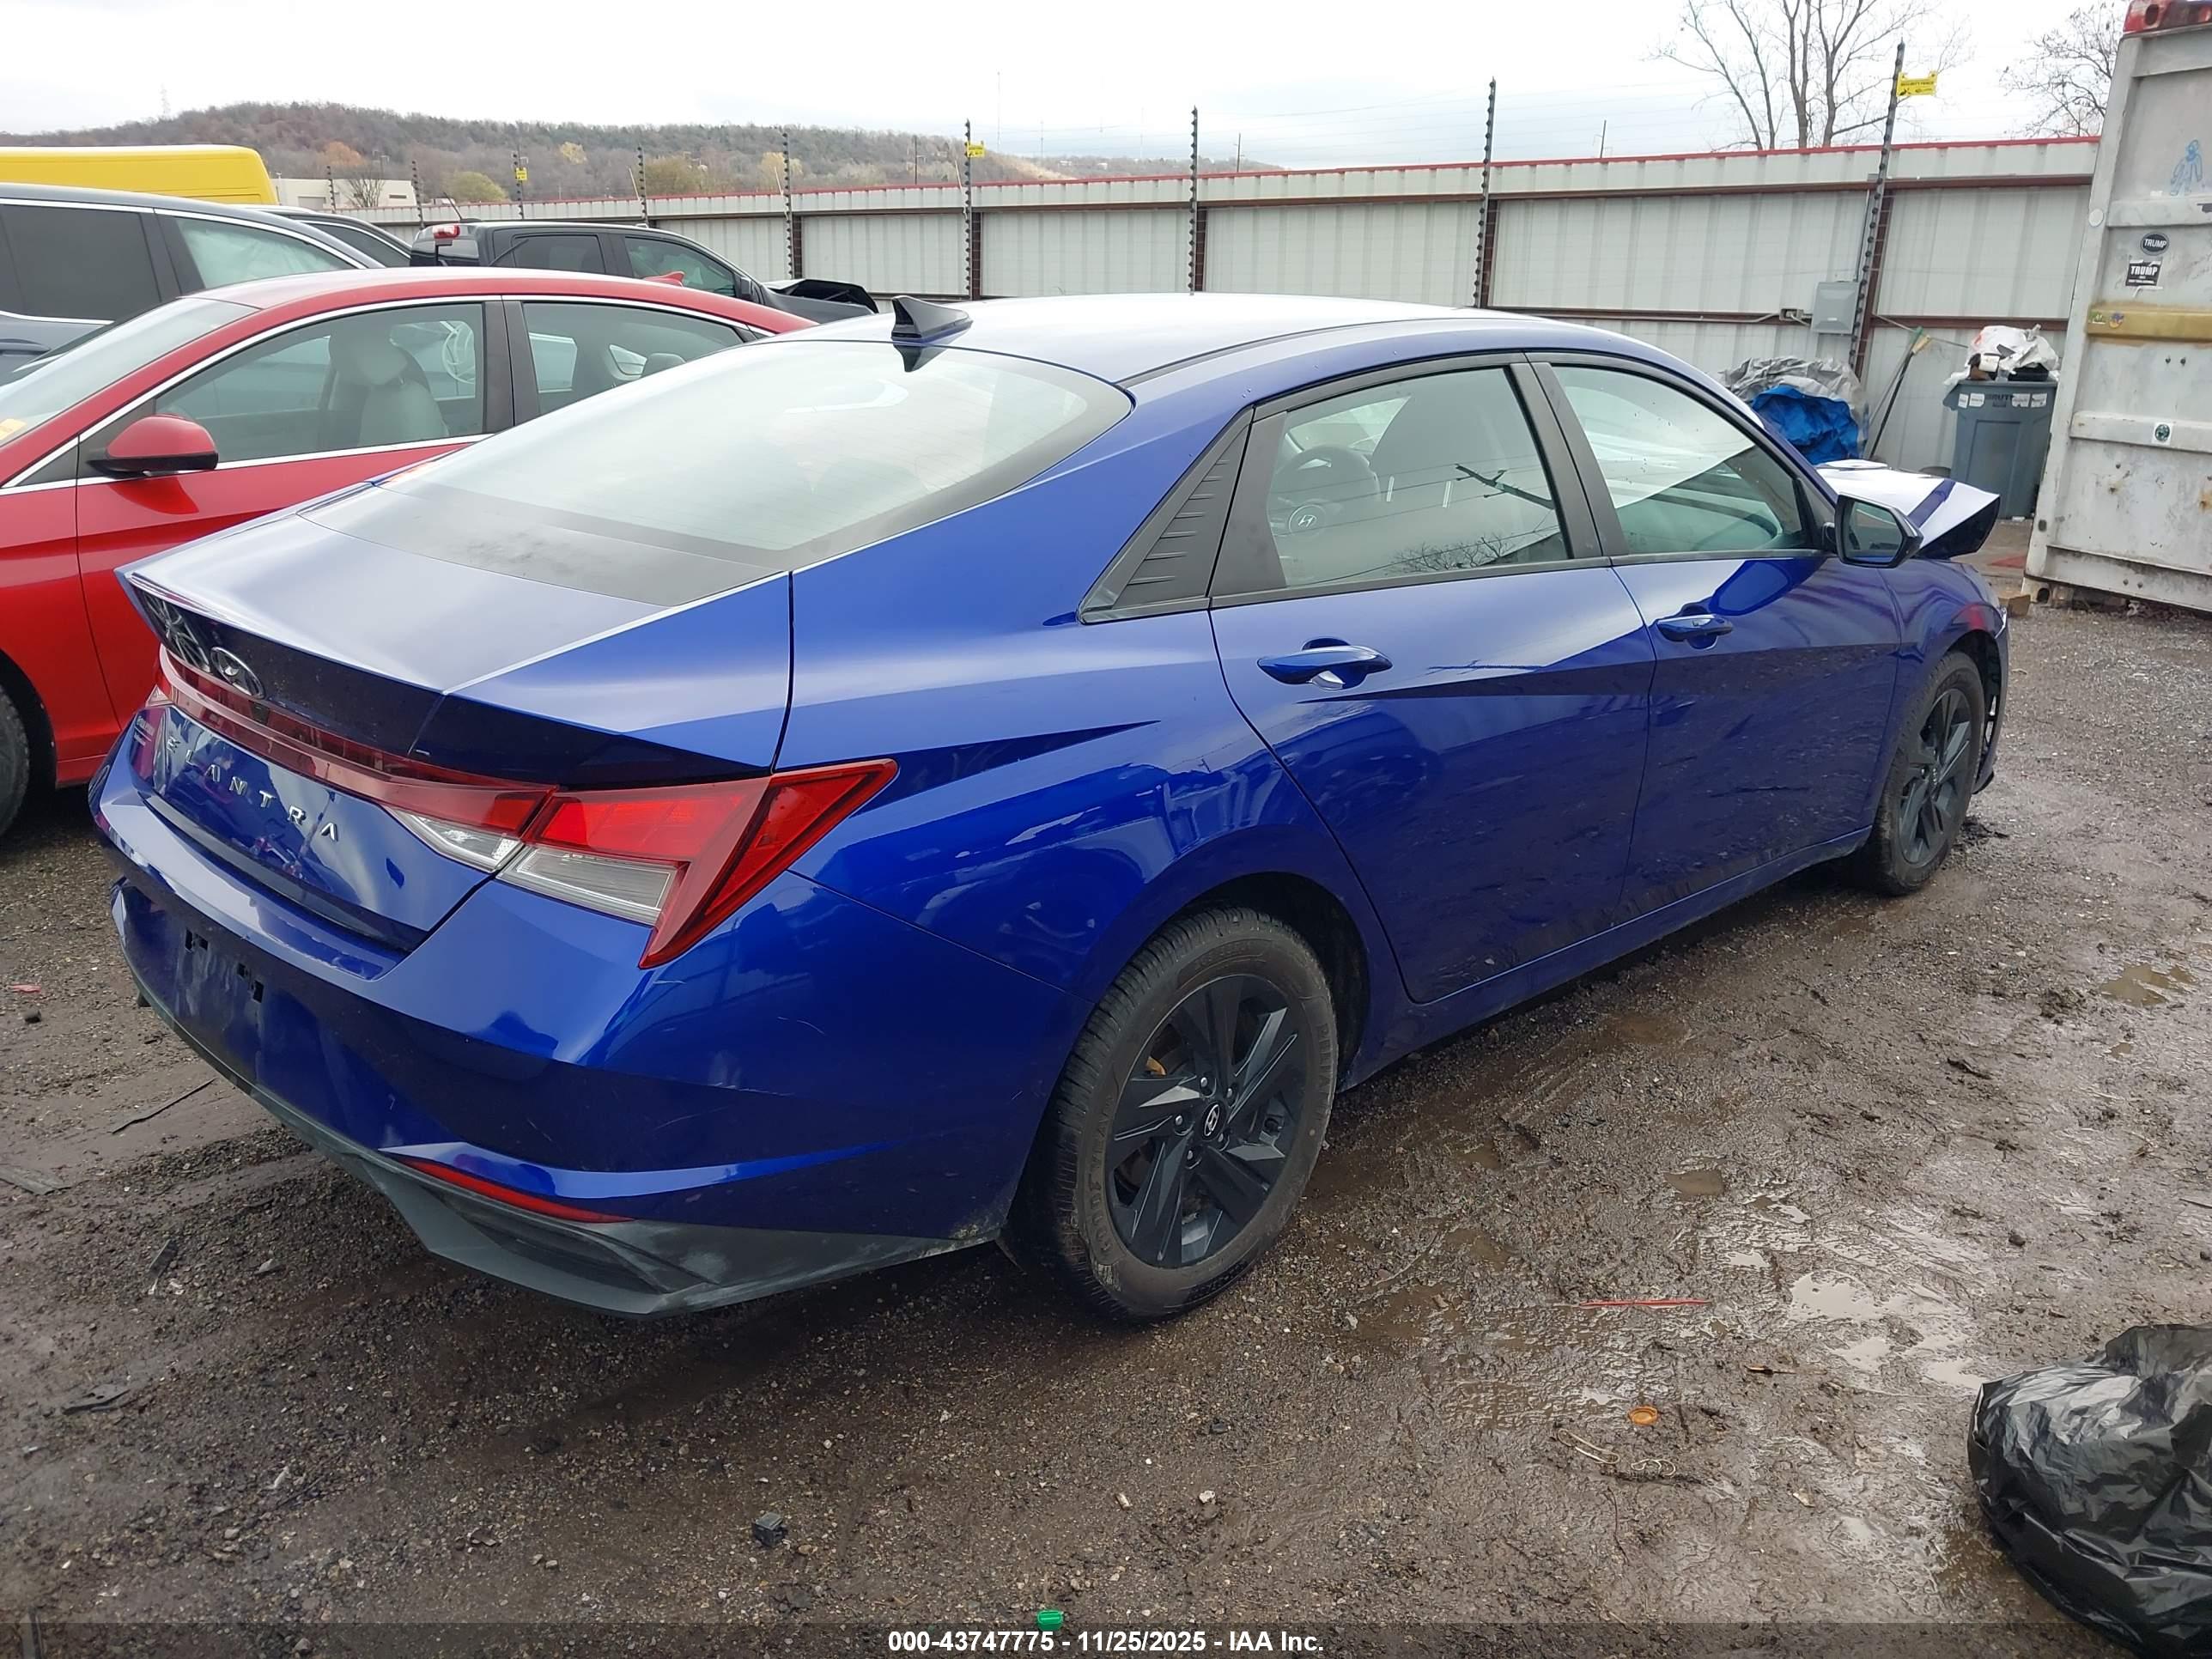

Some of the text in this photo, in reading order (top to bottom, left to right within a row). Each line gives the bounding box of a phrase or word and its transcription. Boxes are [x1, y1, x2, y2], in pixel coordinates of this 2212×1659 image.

[2144, 239, 2166, 248] TRUMP
[2130, 265, 2158, 276] TRUMP
[167, 736, 338, 842] ELANTRA
